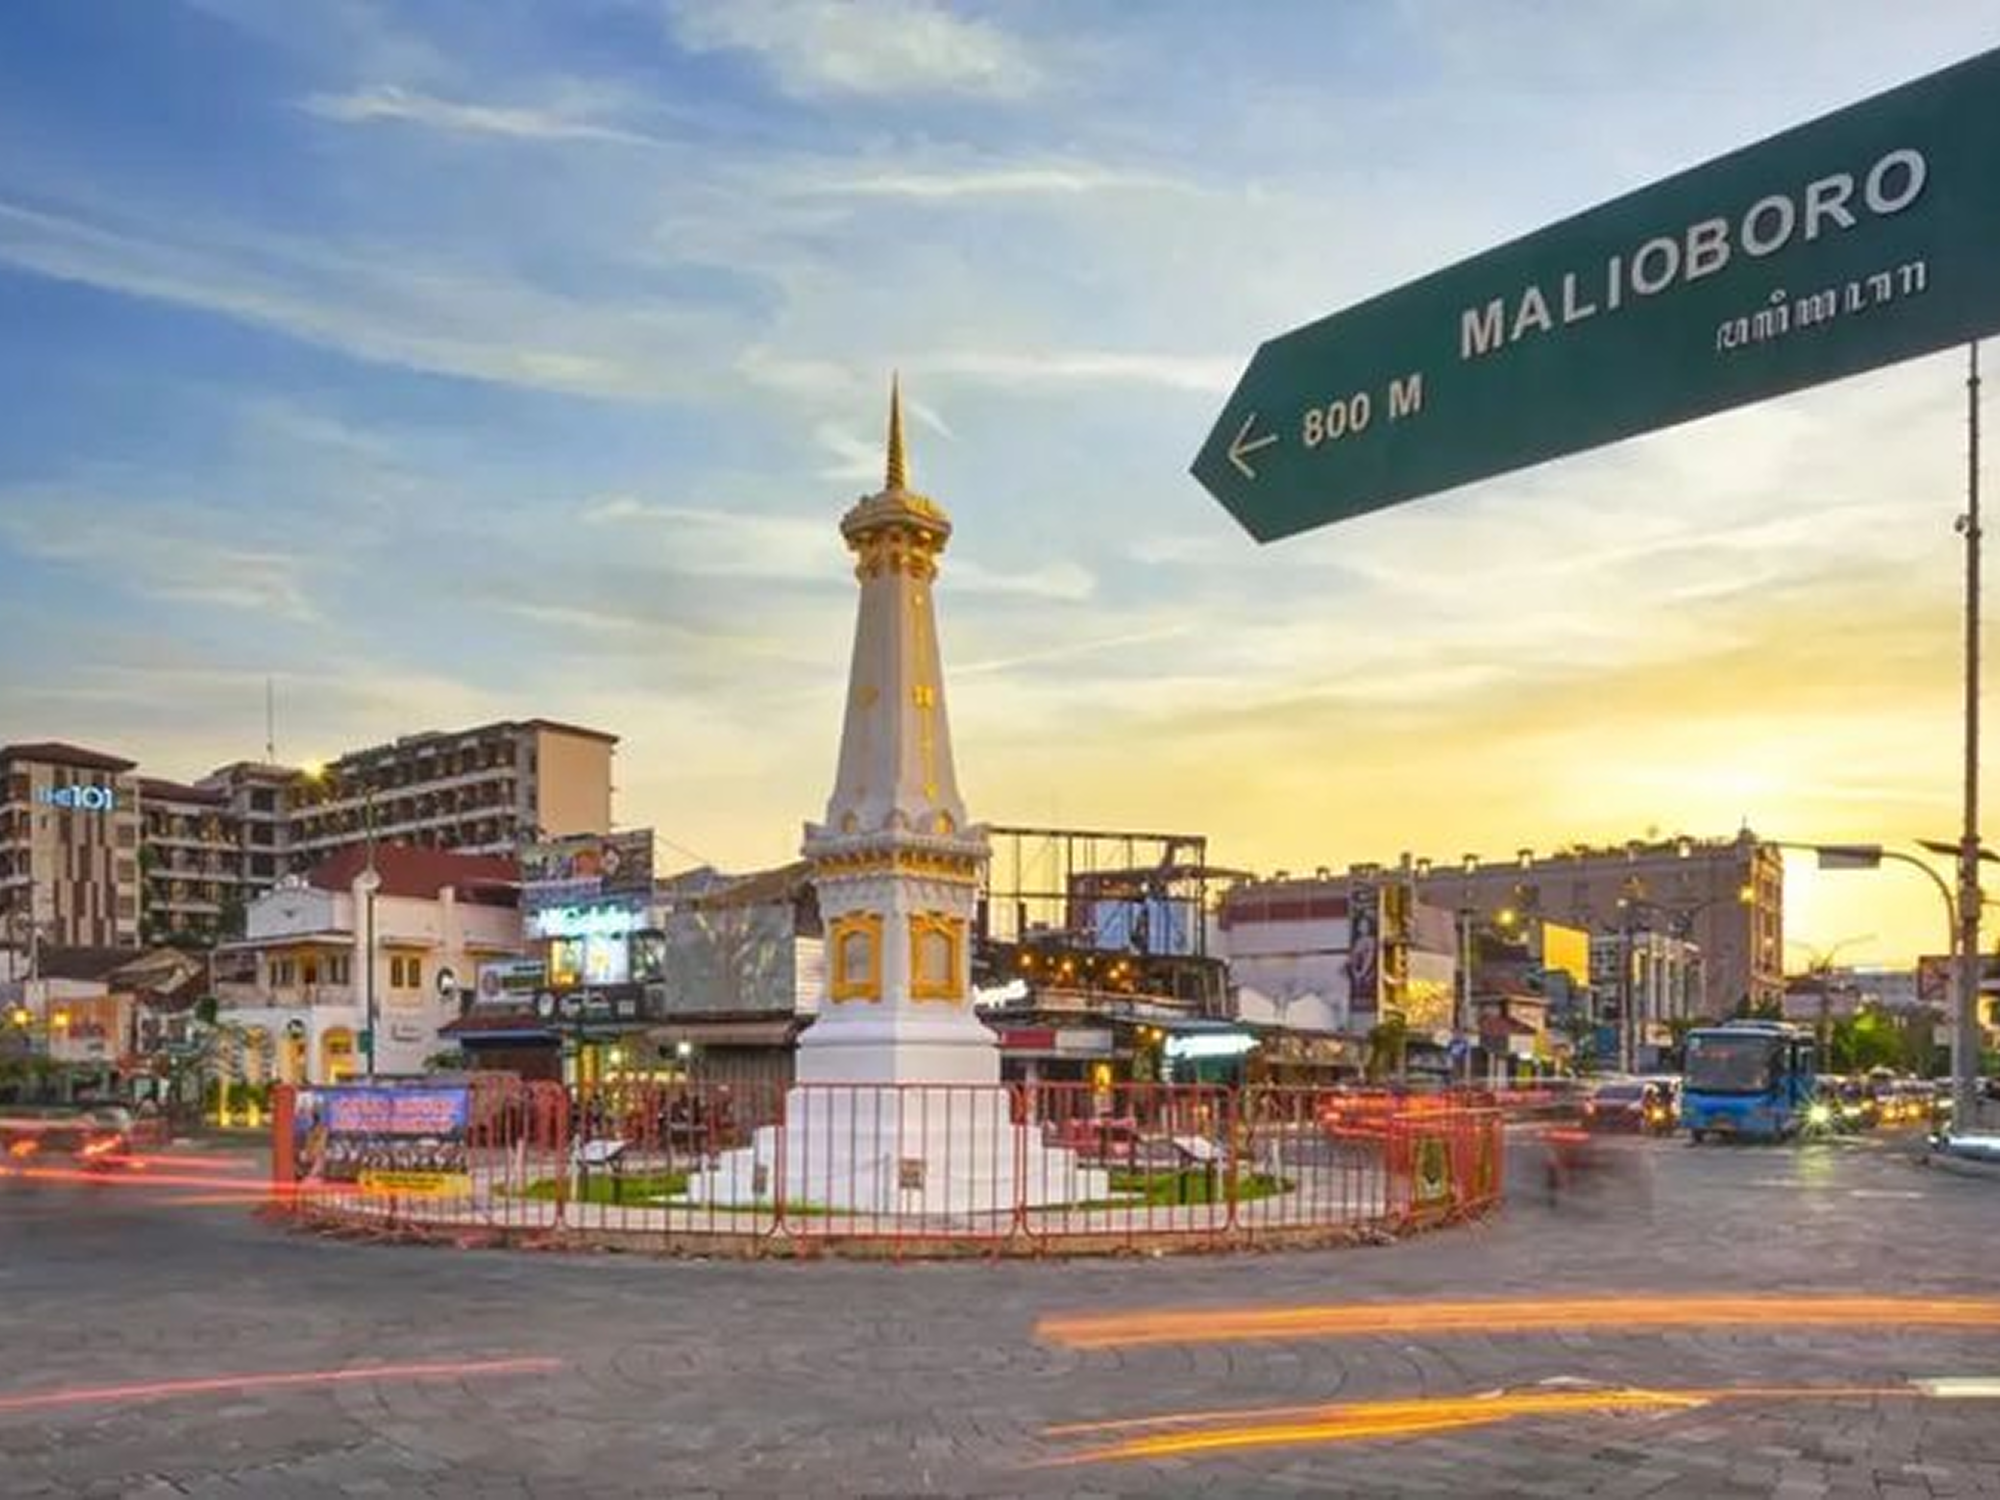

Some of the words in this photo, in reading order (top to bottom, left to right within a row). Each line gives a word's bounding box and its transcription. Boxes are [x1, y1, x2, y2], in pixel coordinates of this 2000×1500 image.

[1460, 148, 1927, 359] MALIOBORO
[1303, 392, 1370, 446] 800
[1389, 373, 1421, 418] M
